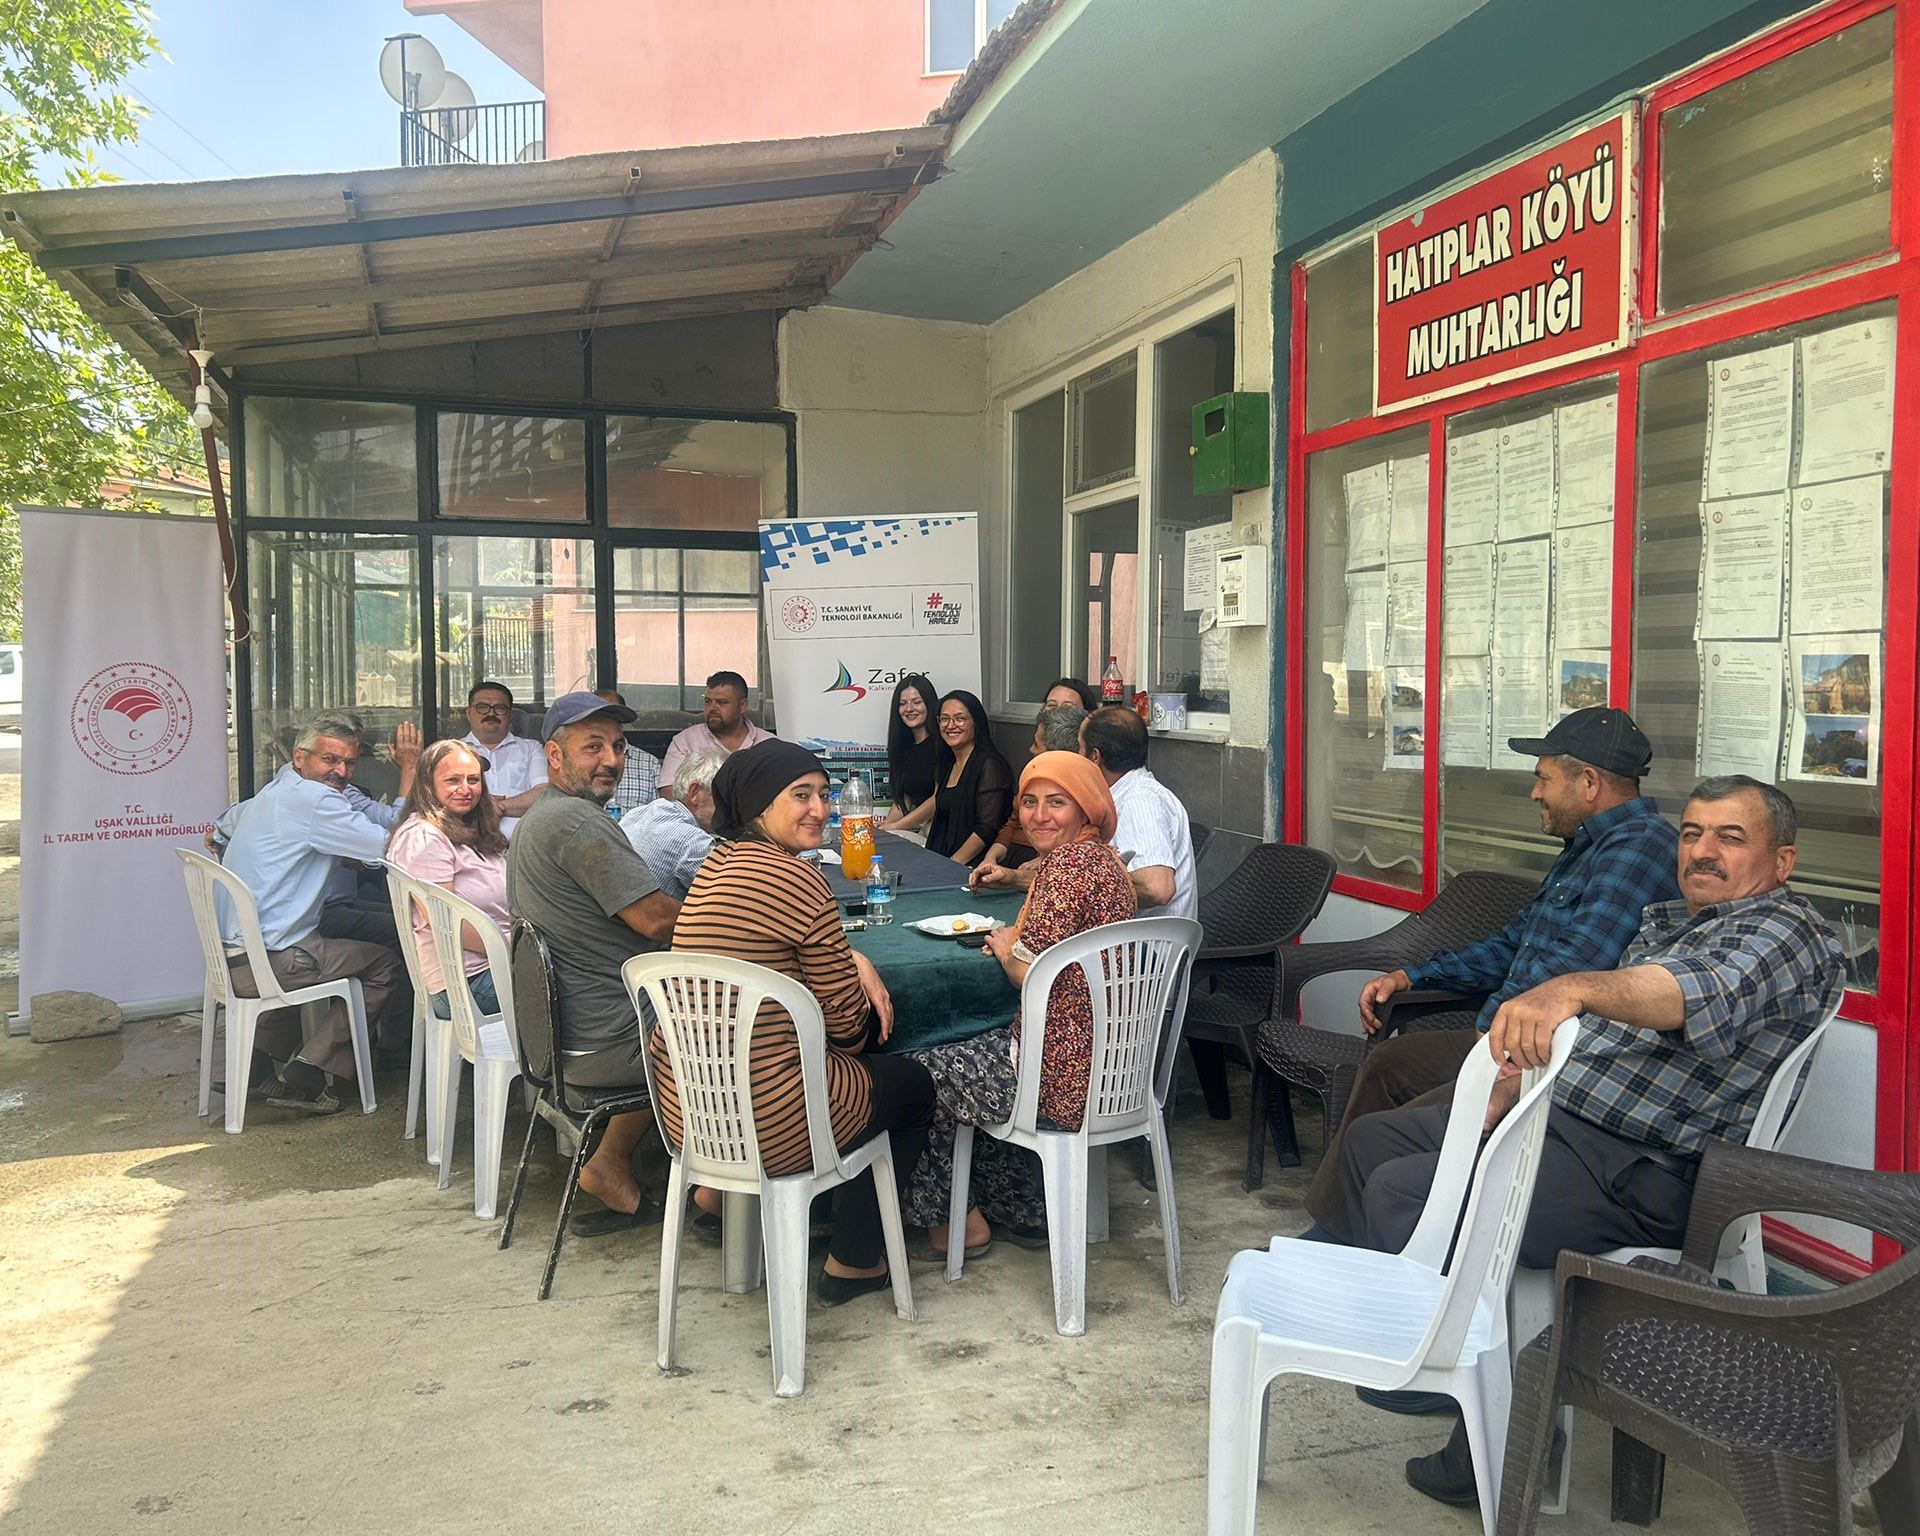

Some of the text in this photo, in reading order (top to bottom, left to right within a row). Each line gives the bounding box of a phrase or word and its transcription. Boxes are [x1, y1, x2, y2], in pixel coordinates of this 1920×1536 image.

[1386, 140, 1616, 305] HATIPLAR KÖYÜ
[1405, 256, 1584, 378] MUHTARLIĞI
[821, 612, 902, 621] TEKNOLOJİ BAKANLIĞI
[835, 605, 861, 613] SANAYİ
[124, 804, 144, 814] T.C.
[95, 813, 173, 830] UŞAK VALİLİĞİ
[43, 833, 54, 844] İL
[57, 833, 94, 843] TARIM
[97, 831, 110, 841] VE
[113, 829, 152, 840] ORMAN
